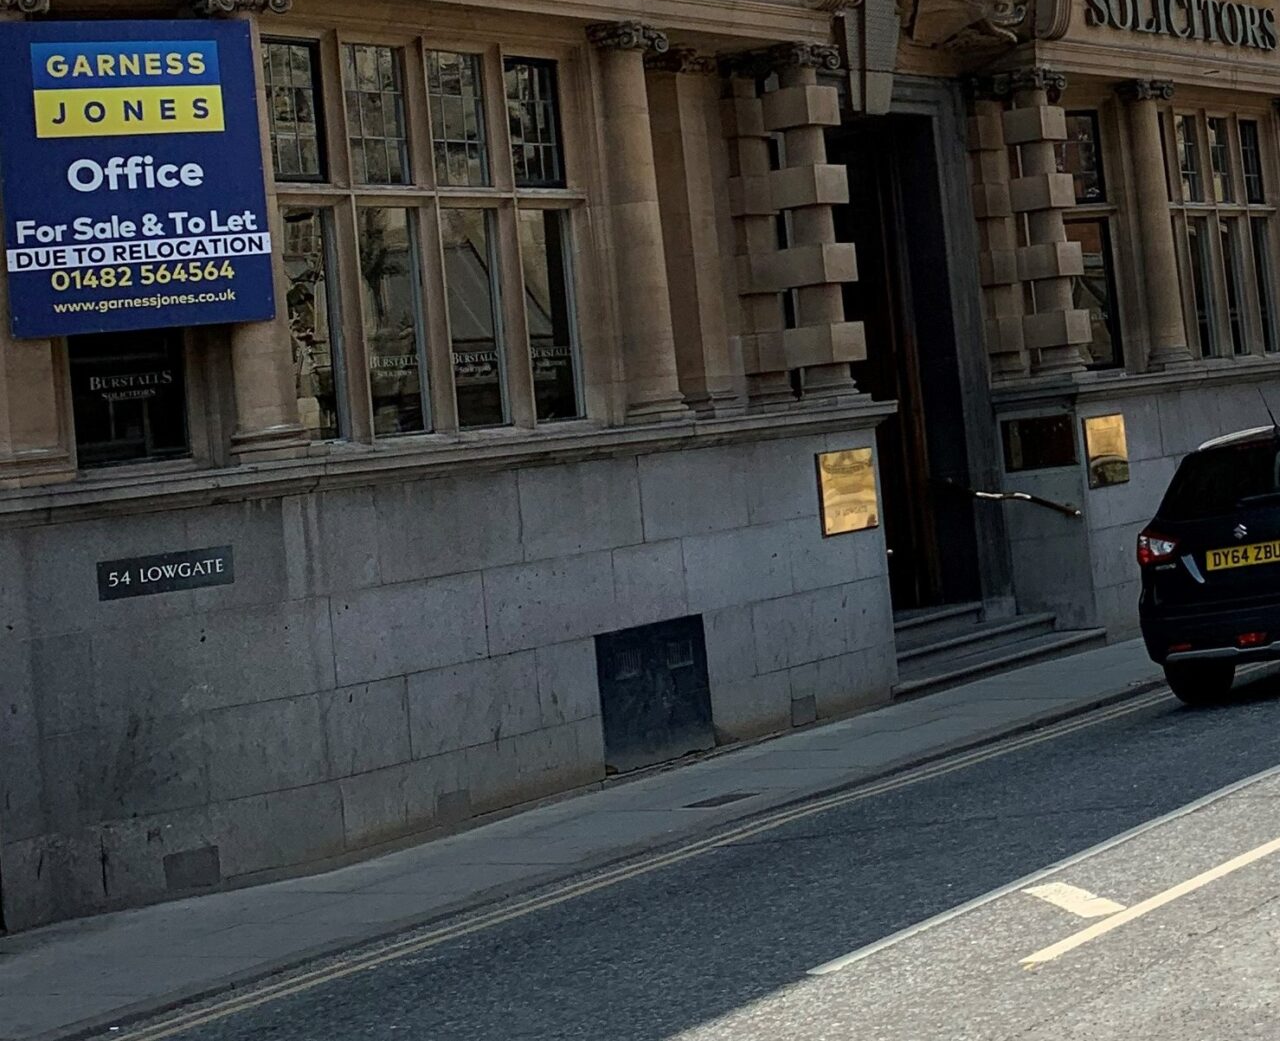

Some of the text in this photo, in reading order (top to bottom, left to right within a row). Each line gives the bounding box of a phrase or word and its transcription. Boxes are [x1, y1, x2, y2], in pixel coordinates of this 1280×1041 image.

[46, 52, 206, 78] GARNESS
[52, 98, 209, 125] JONES
[67, 155, 204, 192] Office
[16, 210, 257, 244] For Sale & To Let
[16, 236, 264, 269] DUE TO RELOCATION
[51, 260, 235, 291] 01482 564564
[53, 288, 236, 313] www.garnessjones.co.uk
[89, 370, 172, 391] BURSTALLS
[108, 558, 224, 587] 54 LOWGATE
[1213, 550, 1249, 568] DY64
